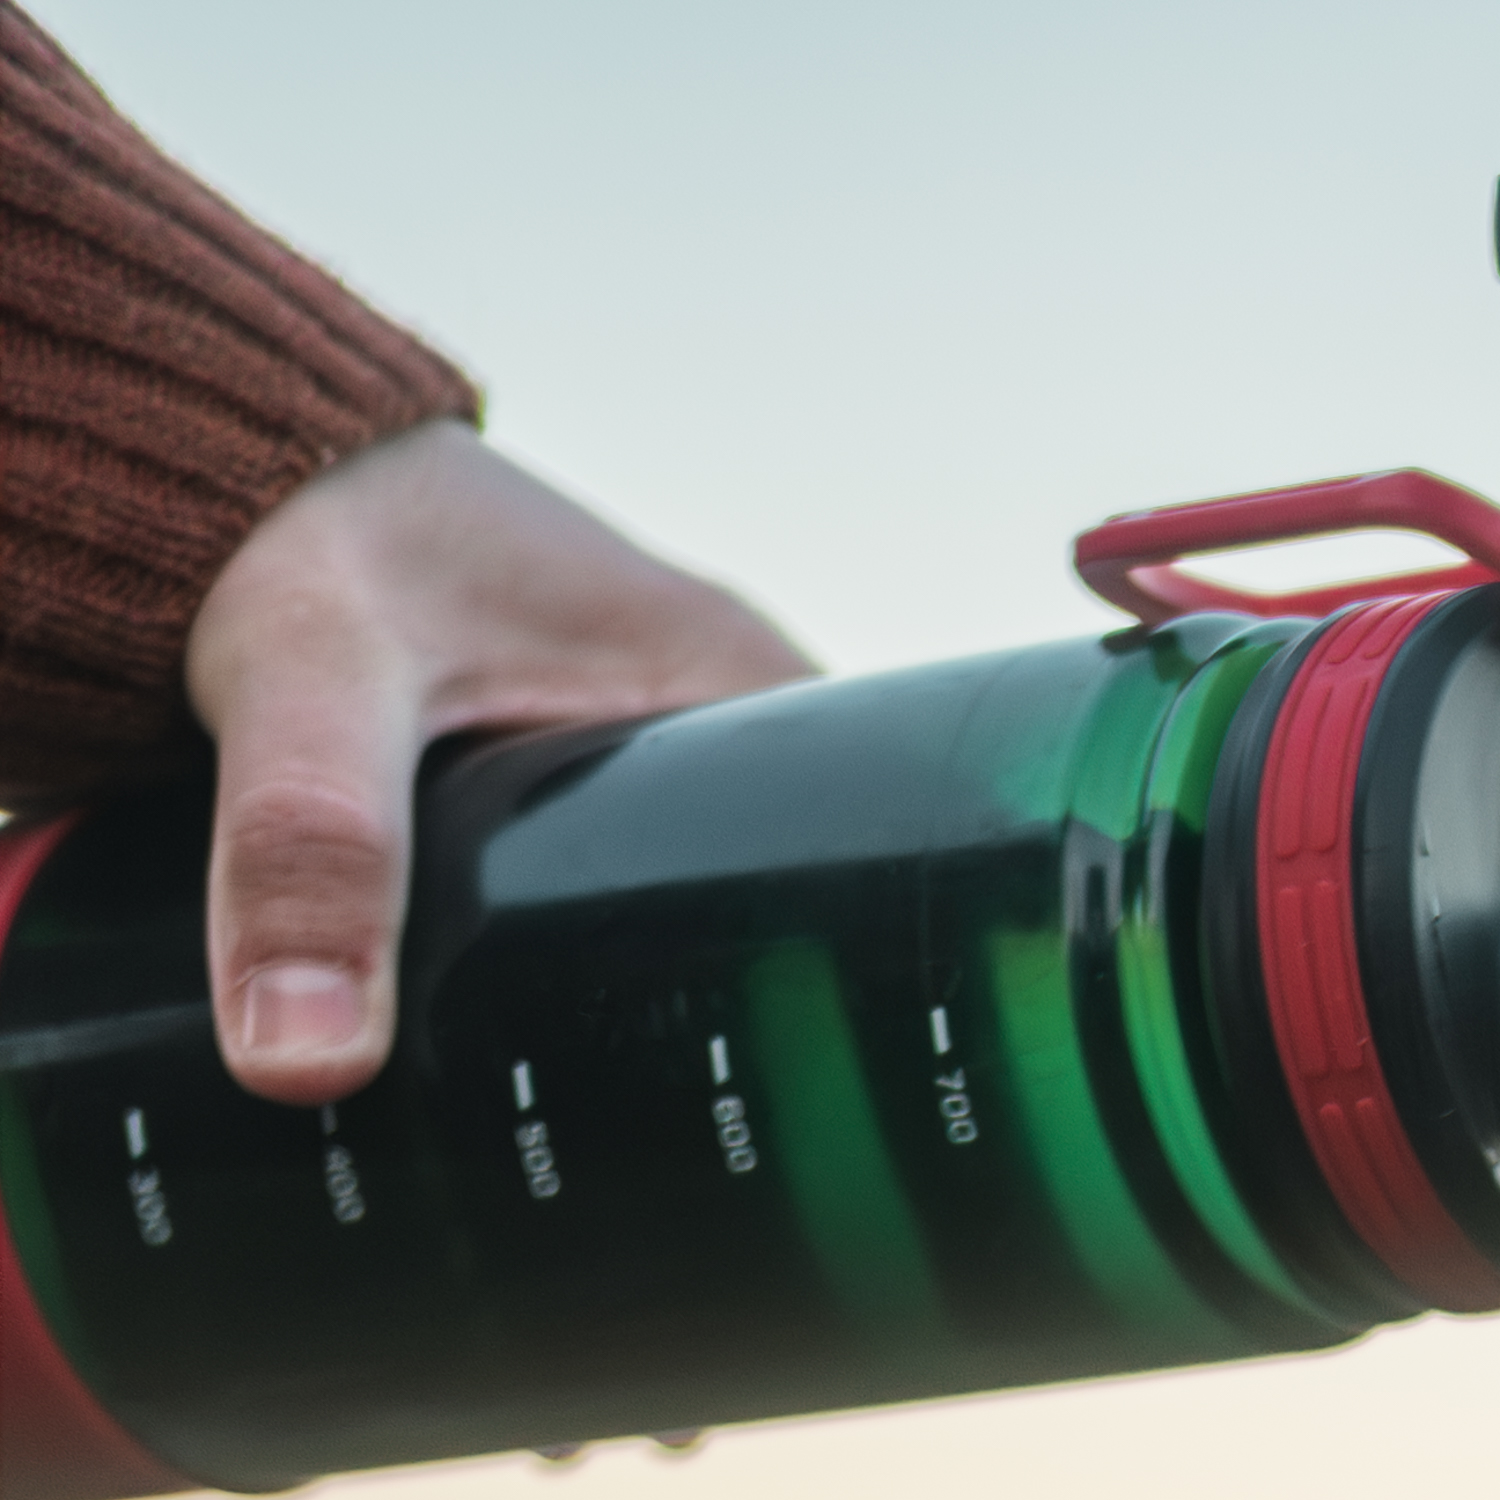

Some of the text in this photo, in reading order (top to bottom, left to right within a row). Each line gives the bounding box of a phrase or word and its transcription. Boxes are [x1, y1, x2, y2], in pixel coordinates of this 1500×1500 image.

[711, 1096, 757, 1175] 600
[935, 1069, 979, 1147] 700
[514, 1121, 562, 1201] 500
